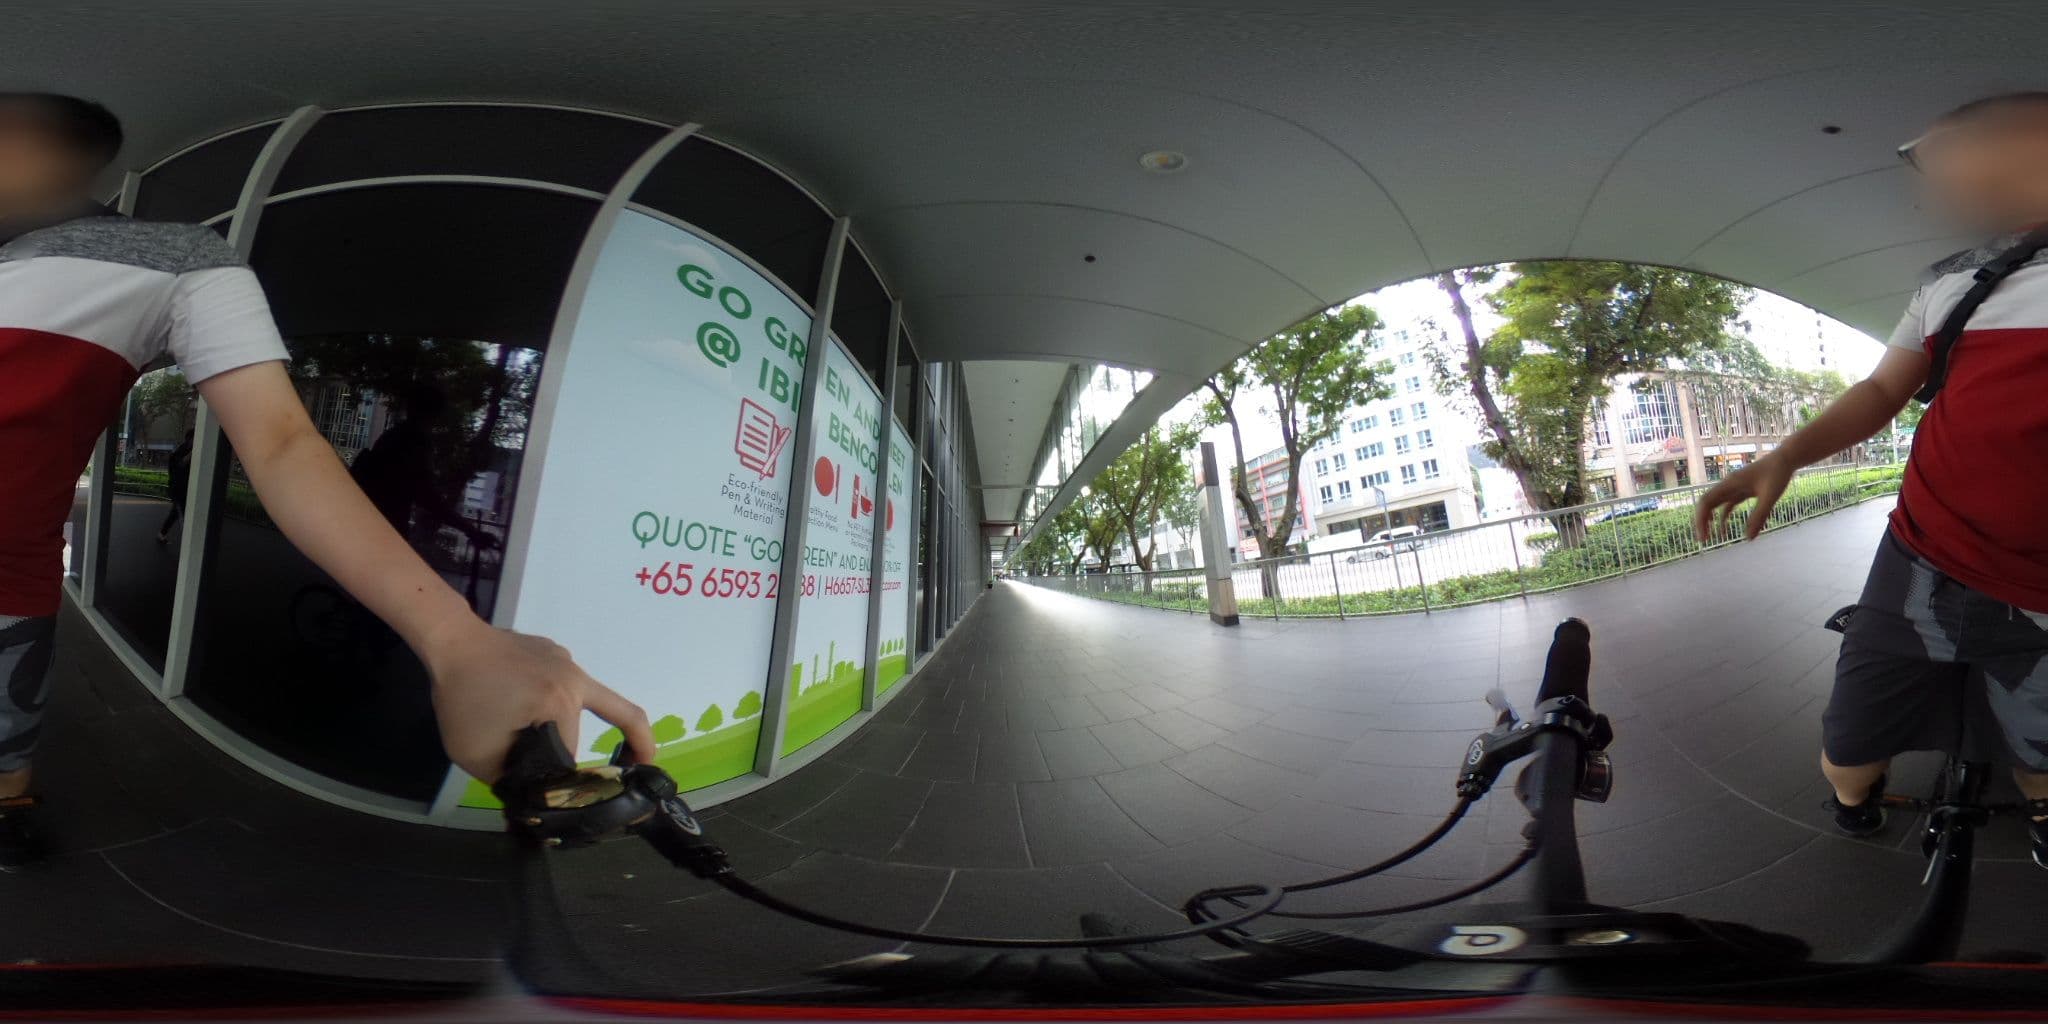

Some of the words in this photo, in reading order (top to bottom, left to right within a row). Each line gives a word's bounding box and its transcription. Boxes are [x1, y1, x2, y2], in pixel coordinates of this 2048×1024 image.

[676, 263, 752, 320] GO
[854, 401, 880, 440] AND
[696, 321, 741, 368] @
[758, 357, 800, 413] IBI
[721, 485, 741, 501] Pen
[743, 493, 751, 505] &
[754, 497, 785, 518] Writing
[728, 473, 784, 503] Eco-friendly
[733, 504, 774, 525] Material
[632, 511, 737, 557] QUOTE
[803, 546, 837, 568] REEN”
[839, 553, 857, 571] AND
[635, 561, 693, 596] +65
[701, 567, 761, 599] 6593
